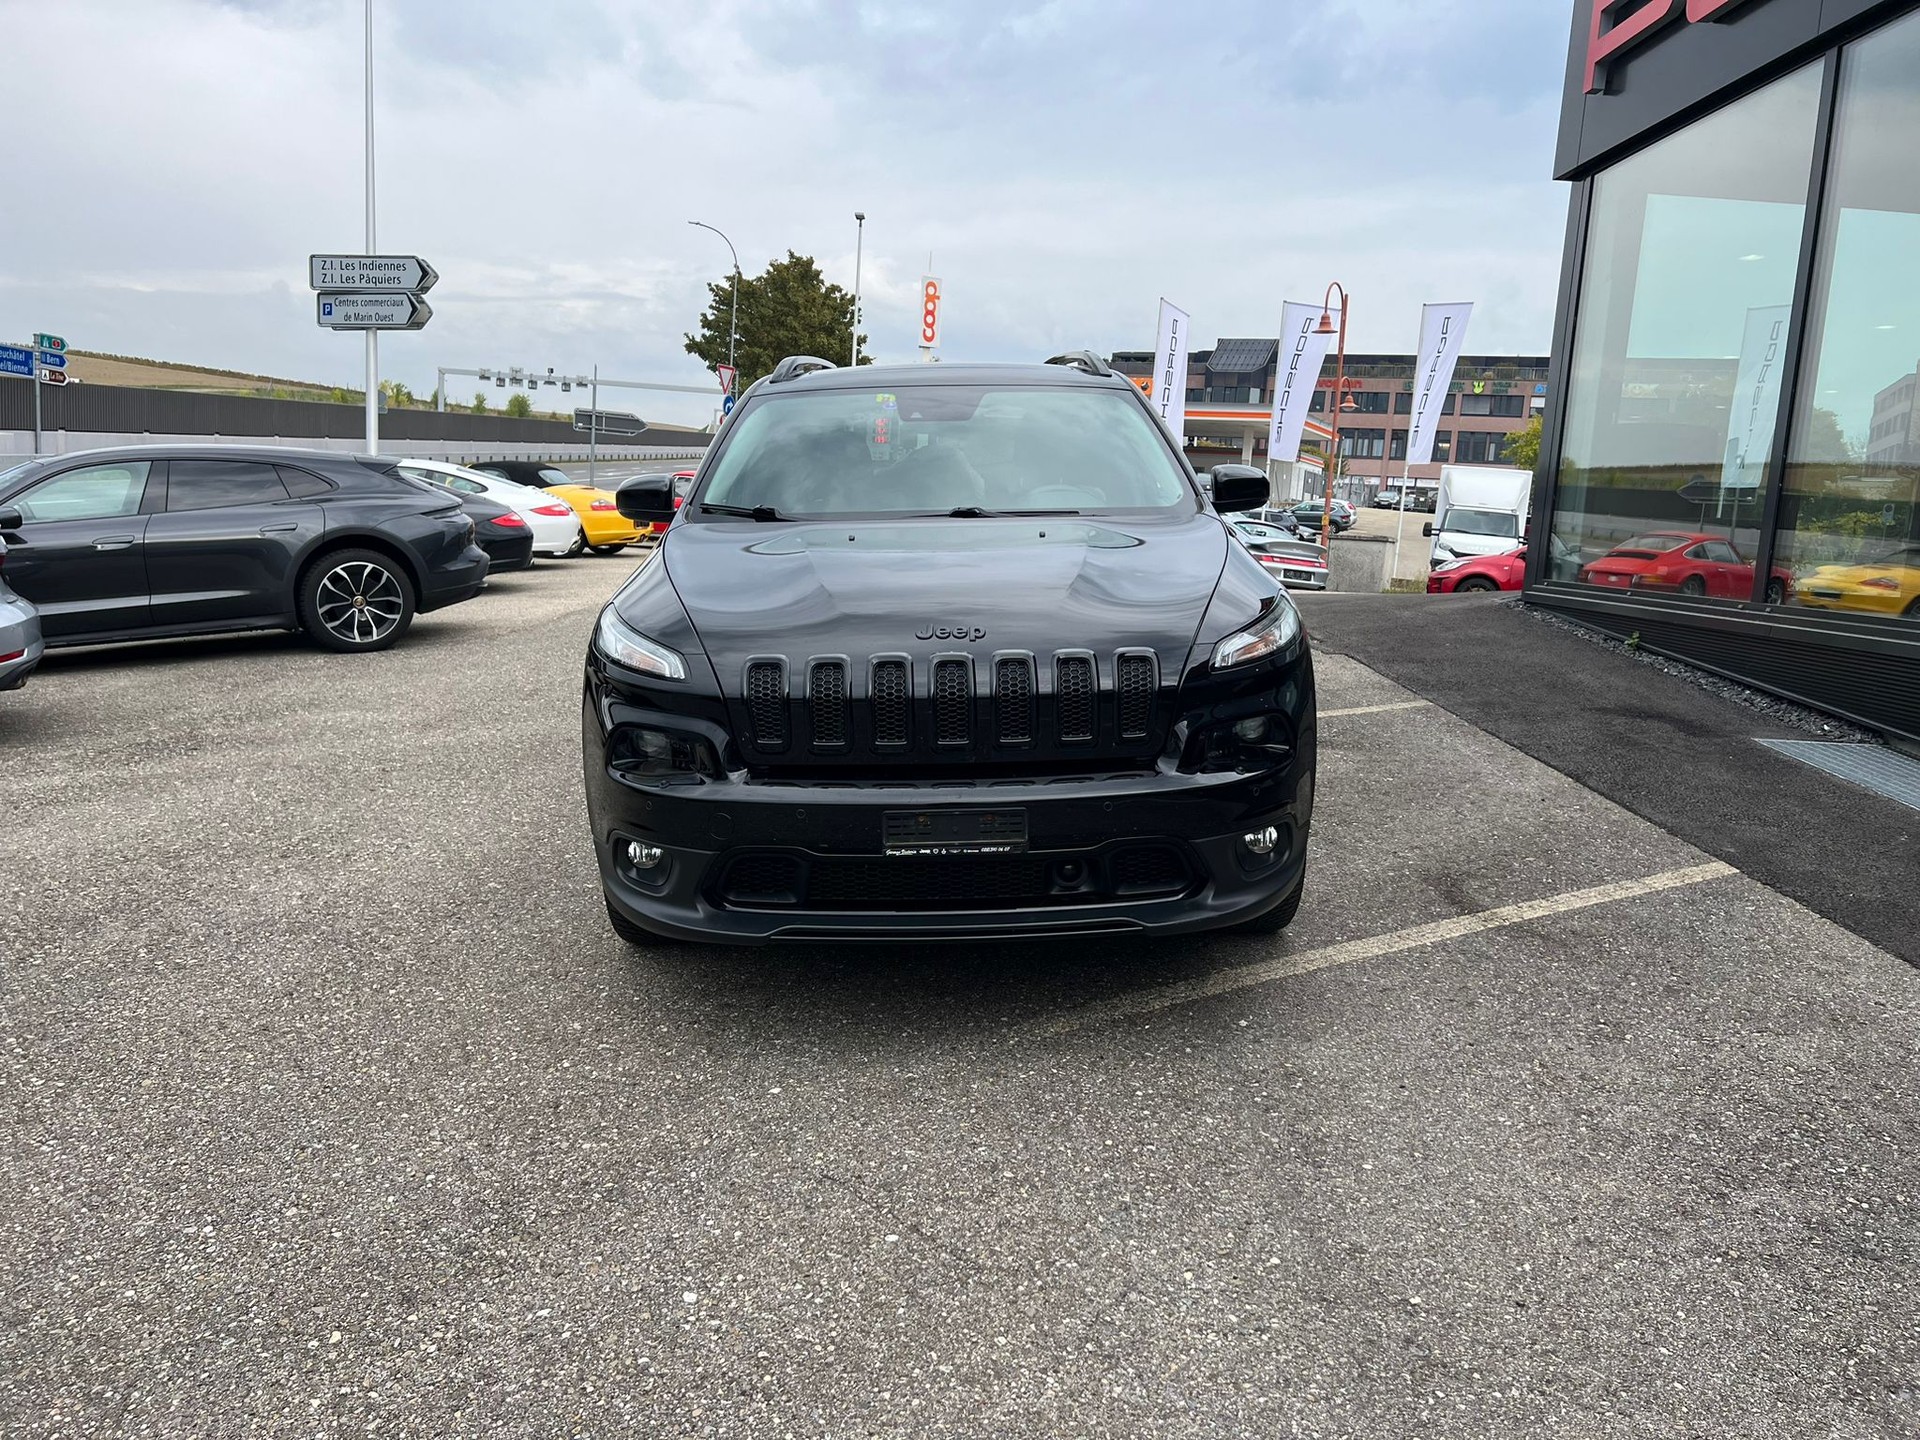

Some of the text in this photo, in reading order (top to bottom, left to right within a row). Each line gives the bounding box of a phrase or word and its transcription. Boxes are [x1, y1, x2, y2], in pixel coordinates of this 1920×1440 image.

[321, 260, 407, 272] Z.I. Les Indiennes
[321, 273, 402, 287] Z.I. Les Pâquiers
[334, 297, 405, 308] Centres commerciaux
[343, 312, 394, 322] de Marin Ouest
[923, 281, 940, 343] coop
[0, 349, 25, 361] euchâtel
[915, 624, 986, 642] Jeep
